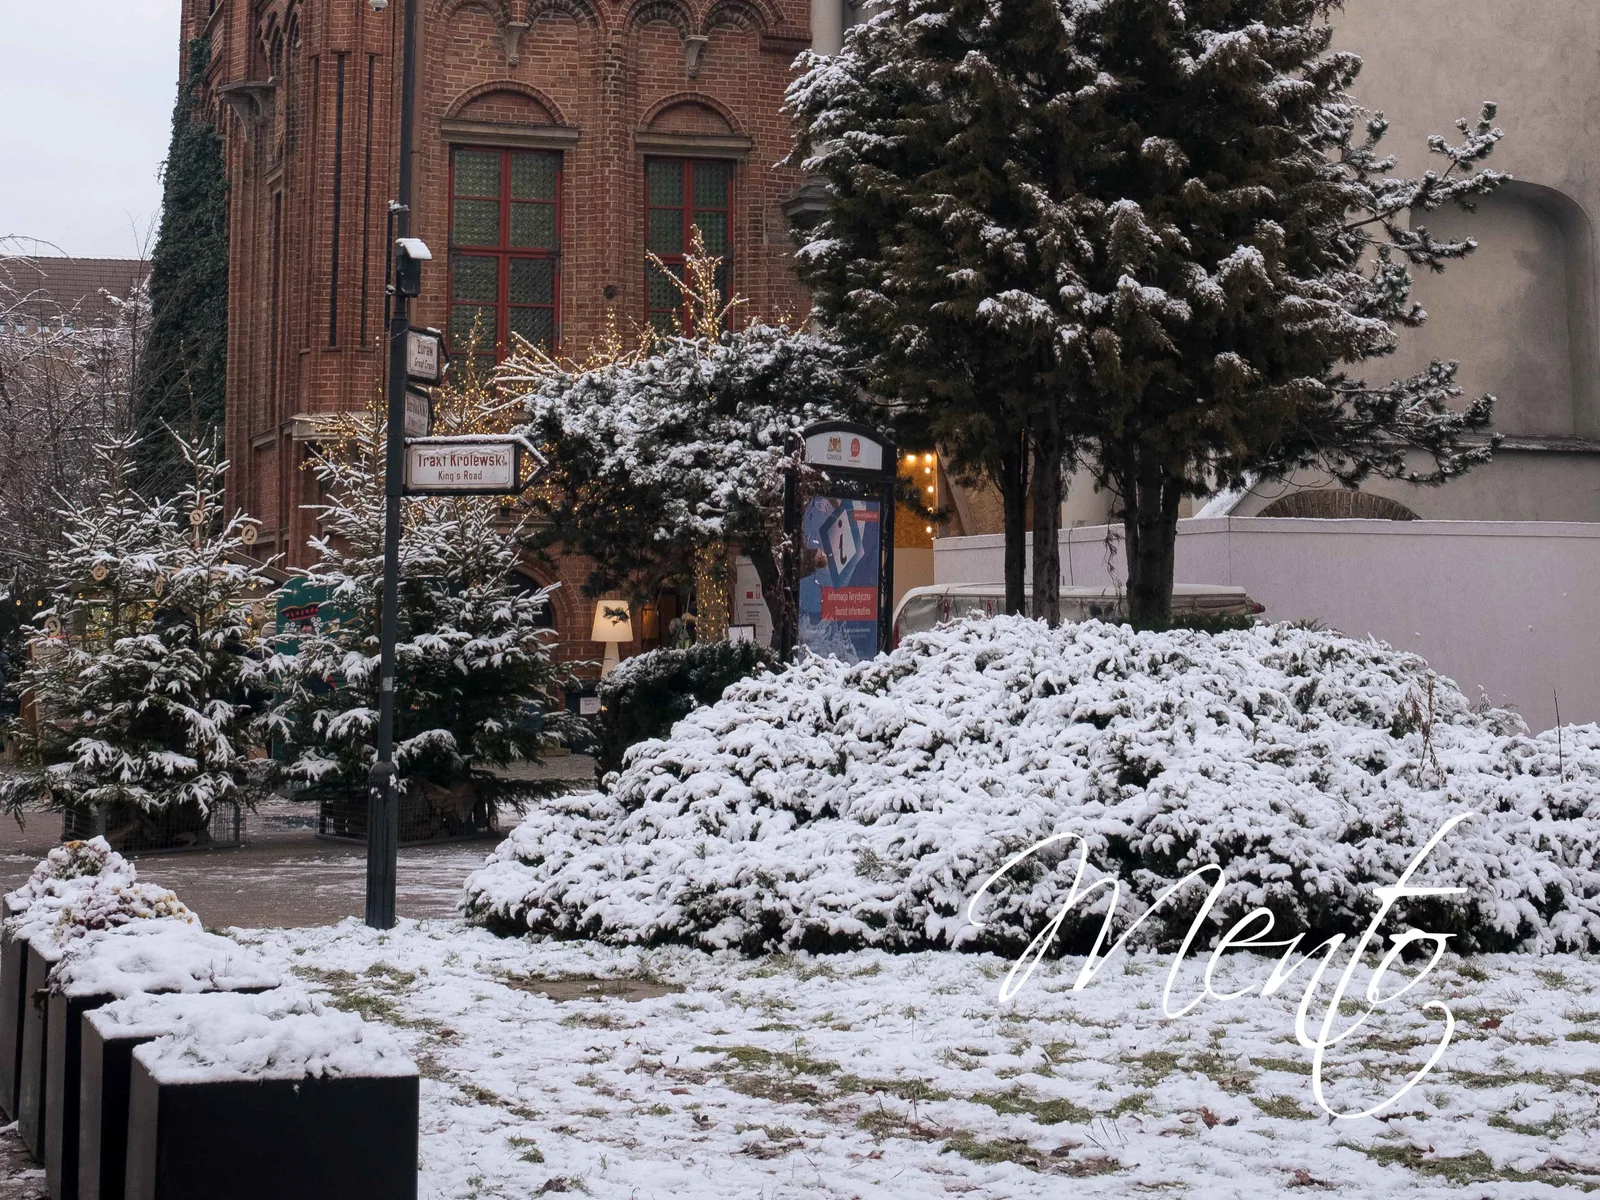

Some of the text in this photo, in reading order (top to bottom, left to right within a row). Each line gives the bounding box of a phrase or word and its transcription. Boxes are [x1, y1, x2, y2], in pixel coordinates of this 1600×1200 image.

[418, 455, 447, 467] Trakt
[438, 470, 483, 482] King's Road
